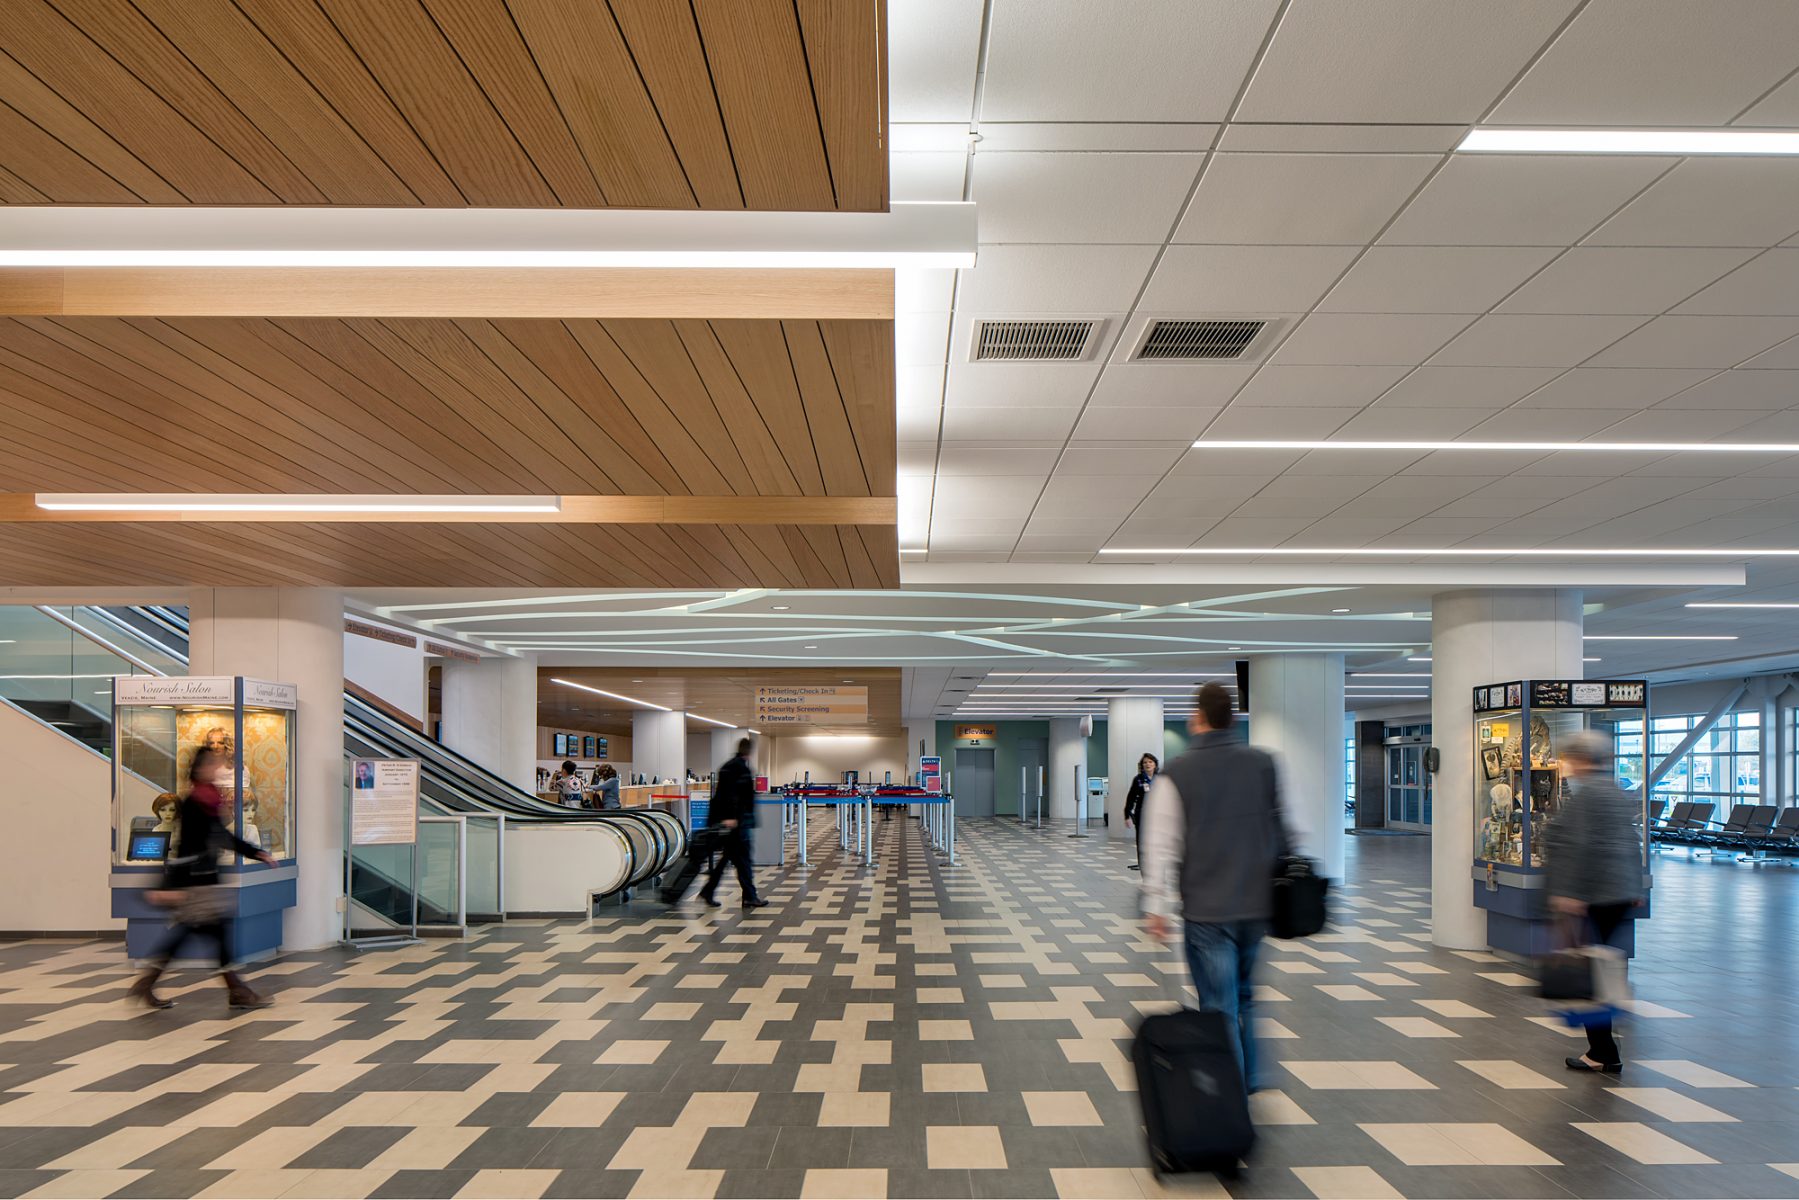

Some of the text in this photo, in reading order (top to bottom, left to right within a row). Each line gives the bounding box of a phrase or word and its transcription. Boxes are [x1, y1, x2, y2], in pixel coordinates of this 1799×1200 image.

[136, 681, 212, 694] Nourish Salon
[767, 687, 819, 695] Ticketing/Check
